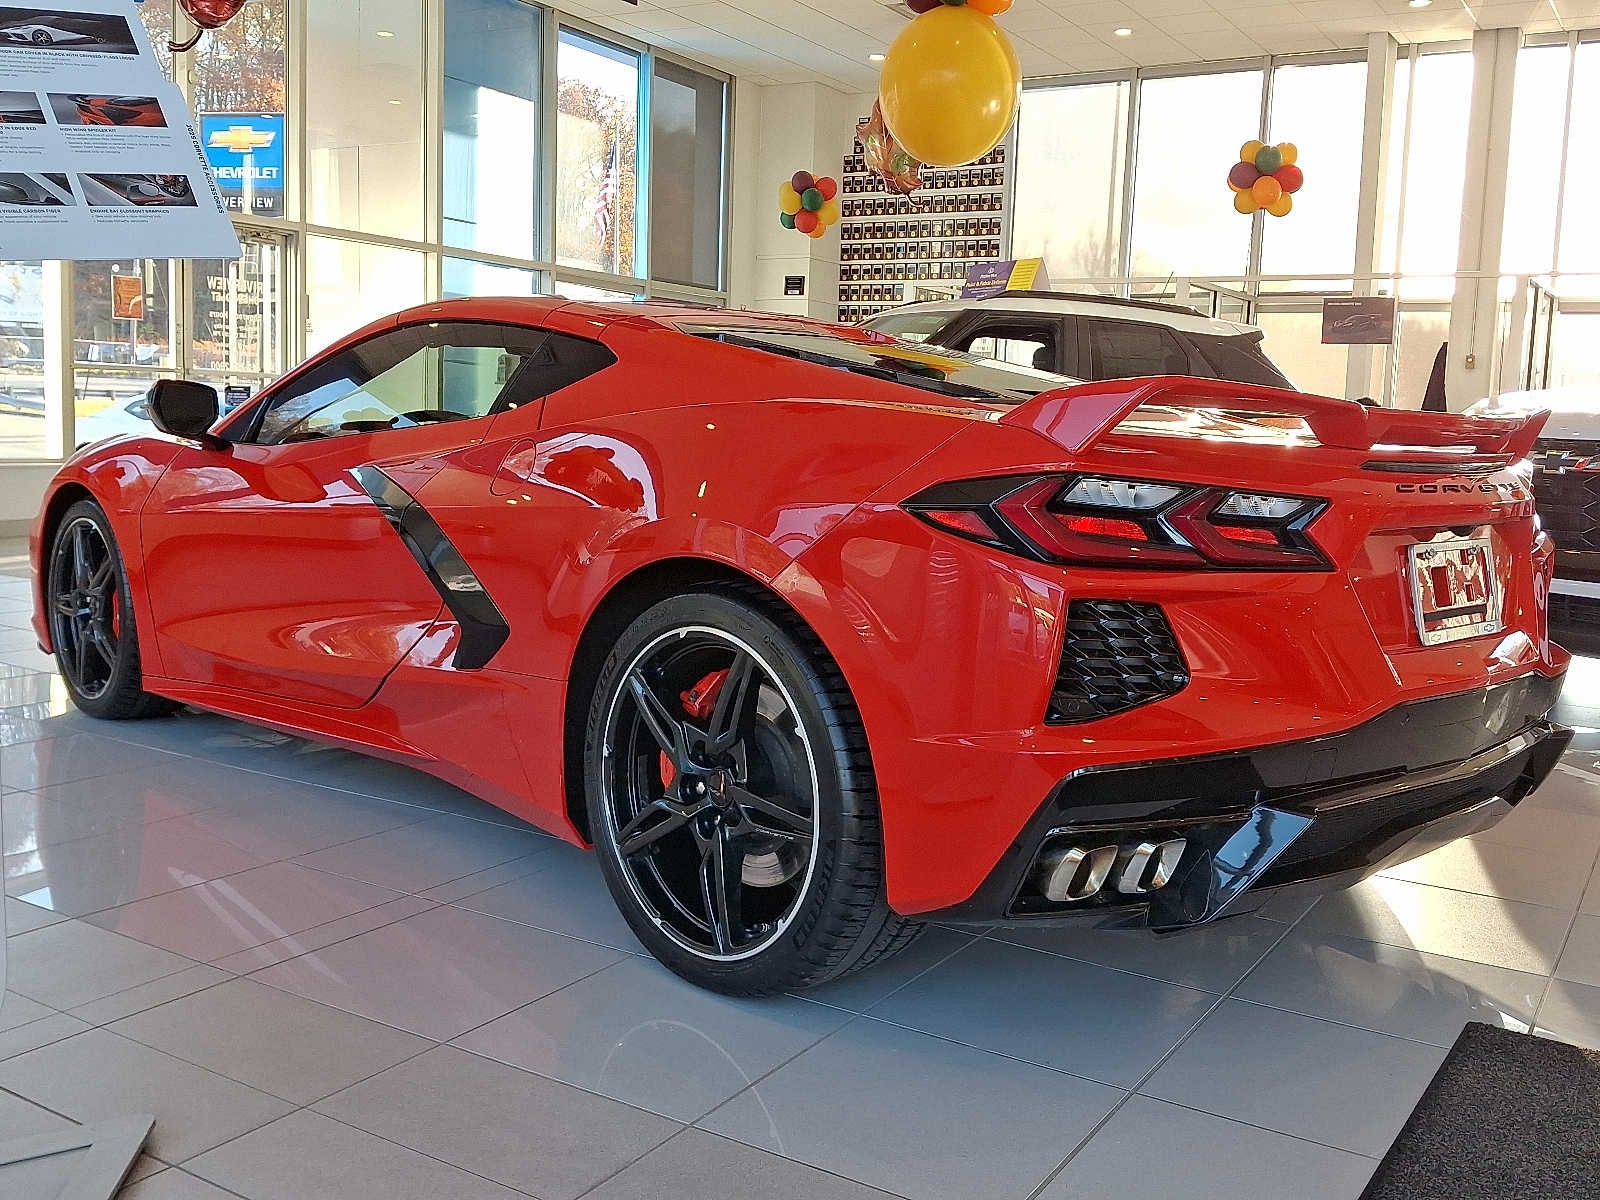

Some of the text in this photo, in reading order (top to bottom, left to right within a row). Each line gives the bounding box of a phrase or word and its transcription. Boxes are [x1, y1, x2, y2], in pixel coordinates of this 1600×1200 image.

[192, 139, 209, 171] CORVETTE
[204, 172, 225, 214] ACCESSORIES
[212, 166, 280, 179] HEVROLET
